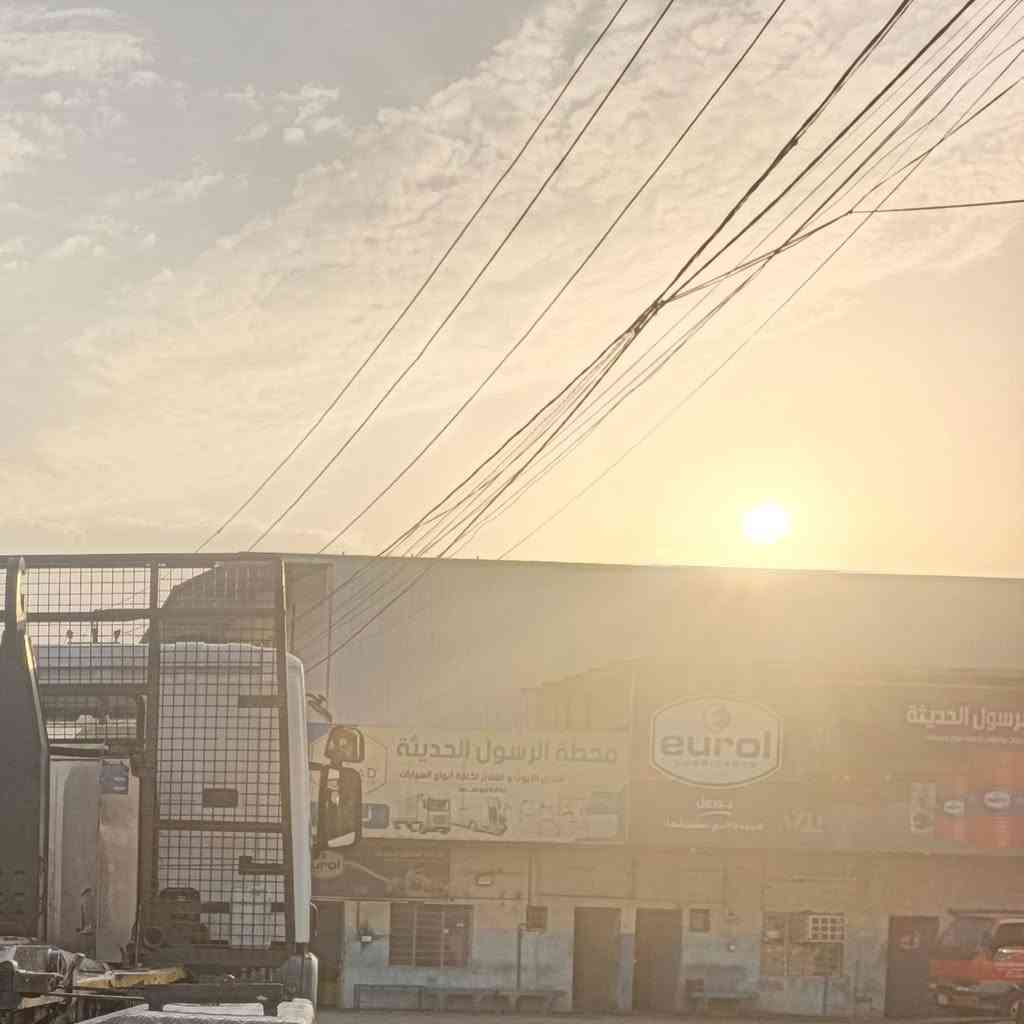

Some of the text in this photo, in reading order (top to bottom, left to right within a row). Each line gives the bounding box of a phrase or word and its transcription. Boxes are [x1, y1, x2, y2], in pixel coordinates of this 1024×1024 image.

[396, 734, 470, 763] الحديثة
[476, 736, 550, 765] الرسول
[660, 730, 771, 759] eurol
[312, 859, 341, 873] urol
